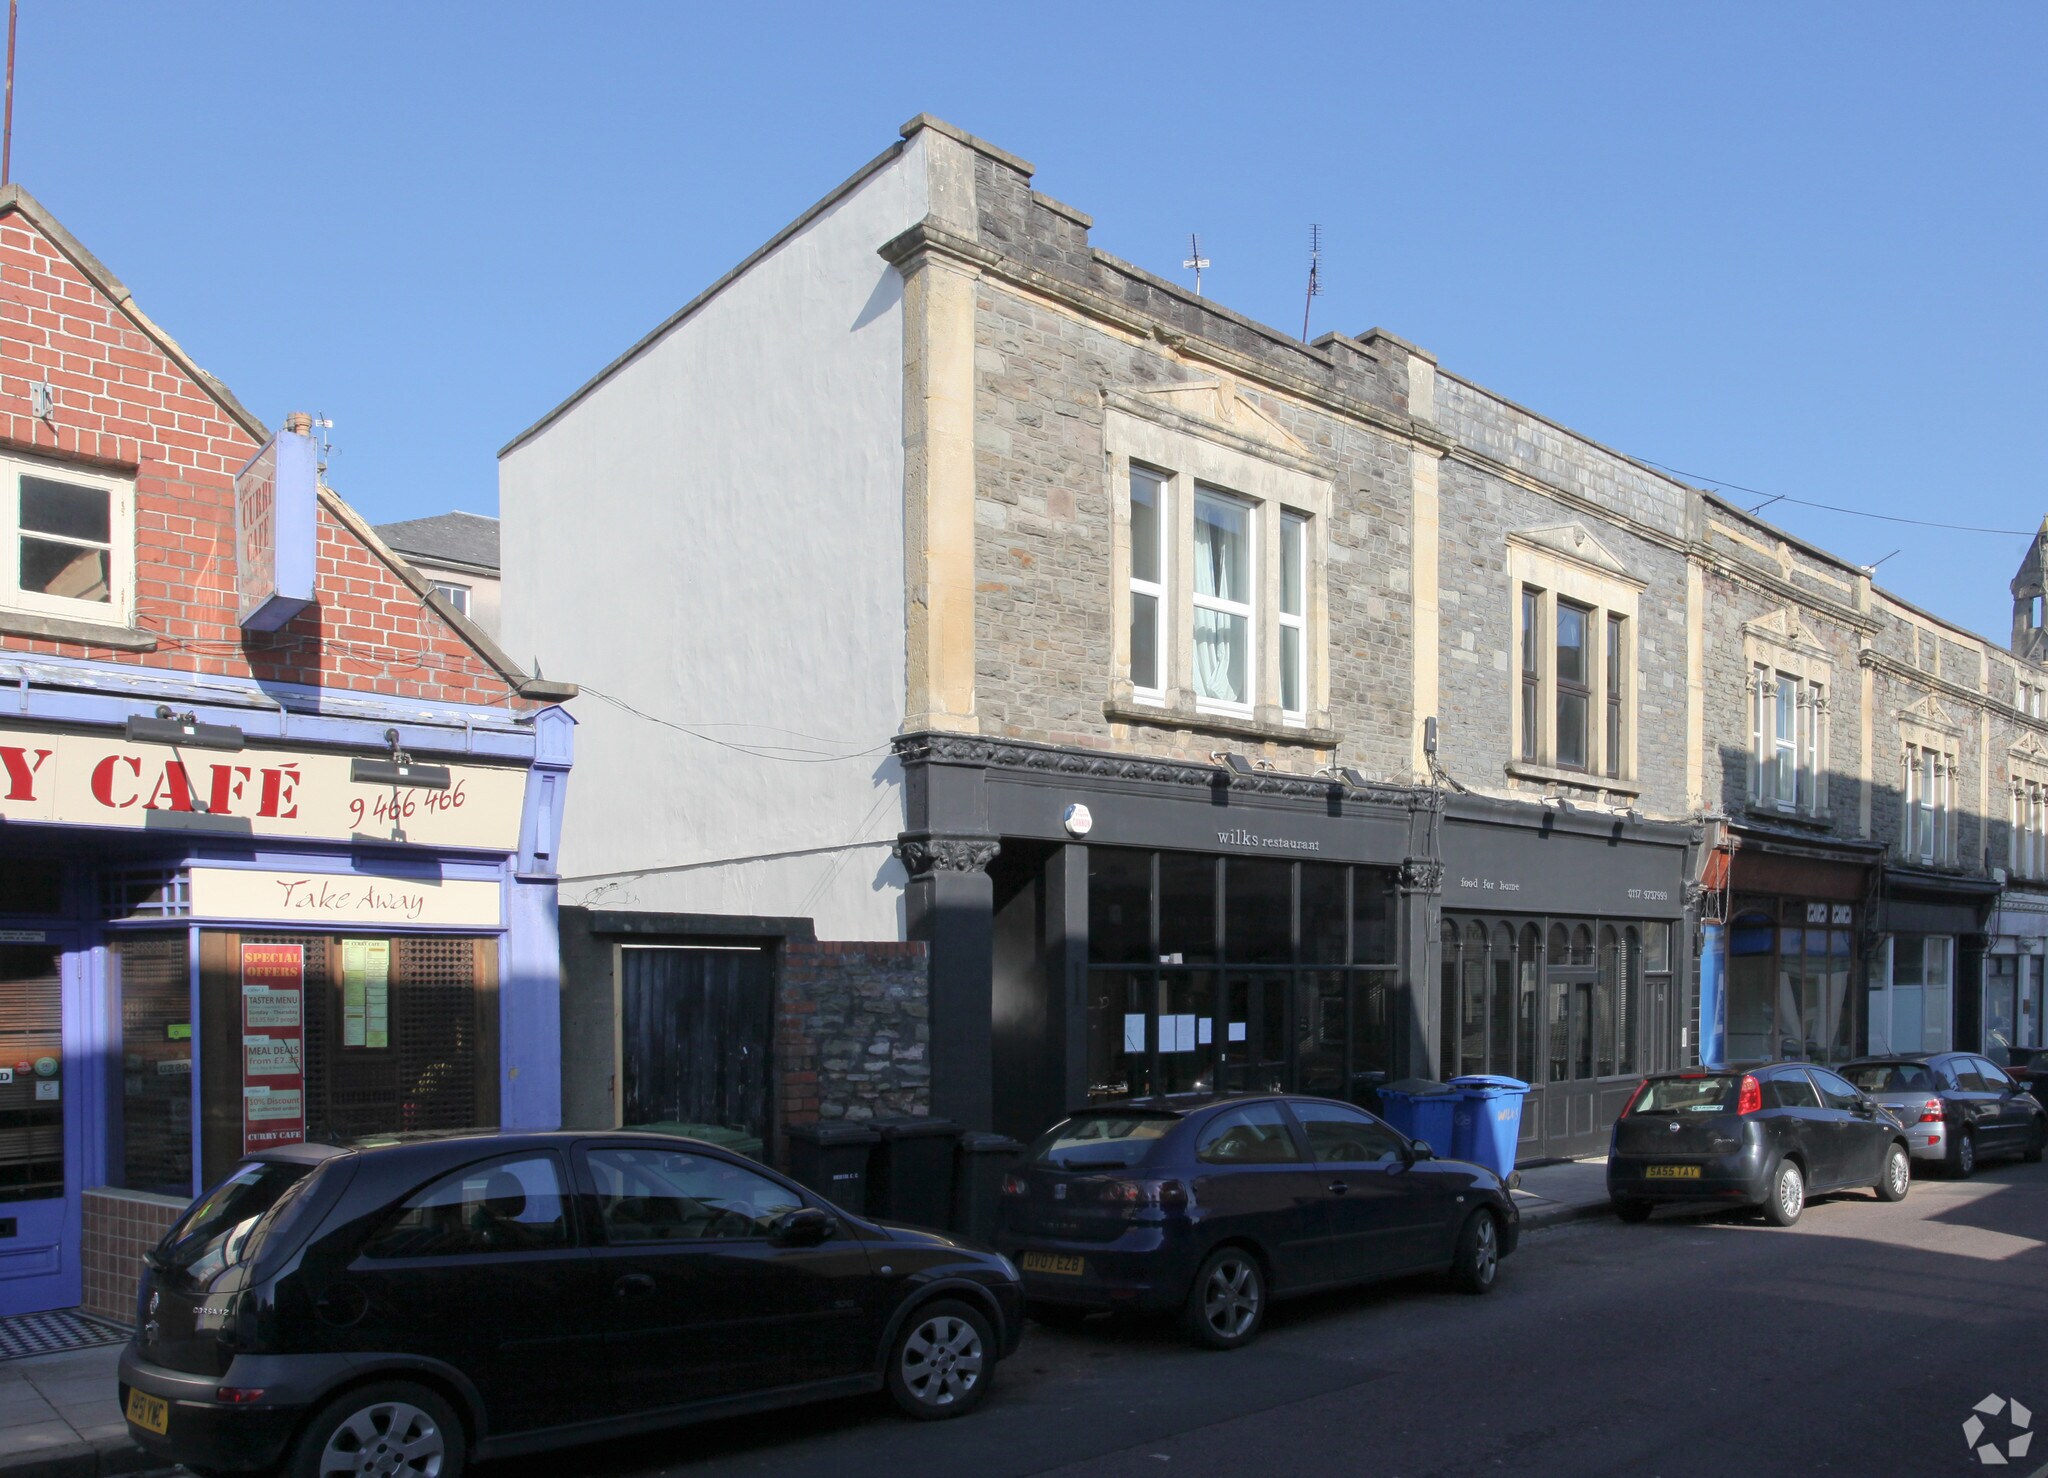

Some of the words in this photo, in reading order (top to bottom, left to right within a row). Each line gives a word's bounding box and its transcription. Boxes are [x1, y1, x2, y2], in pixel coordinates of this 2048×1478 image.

[91, 755, 300, 819] CAFÉ
[349, 799, 365, 829] 9
[374, 788, 416, 824] 466
[424, 779, 466, 814] 466
[1218, 829, 1258, 846] wilks
[1262, 838, 1320, 850] restaurant
[1460, 877, 1478, 888] food
[1483, 879, 1494, 889] for
[1500, 881, 1520, 890] home
[1628, 889, 1641, 898] 0117
[276, 880, 350, 910] Take
[356, 886, 424, 919] Away
[245, 952, 300, 962] SPECIAL
[247, 966, 298, 976] OFFERS
[276, 996, 298, 1004] MENU
[249, 1047, 271, 1055] MEAL
[274, 1046, 299, 1054] DEALS
[248, 1132, 278, 1140] CURRY
[280, 1131, 301, 1139] CAFE
[1650, 1167, 1674, 1176] SA55
[192, 1306, 218, 1315] CORSA
